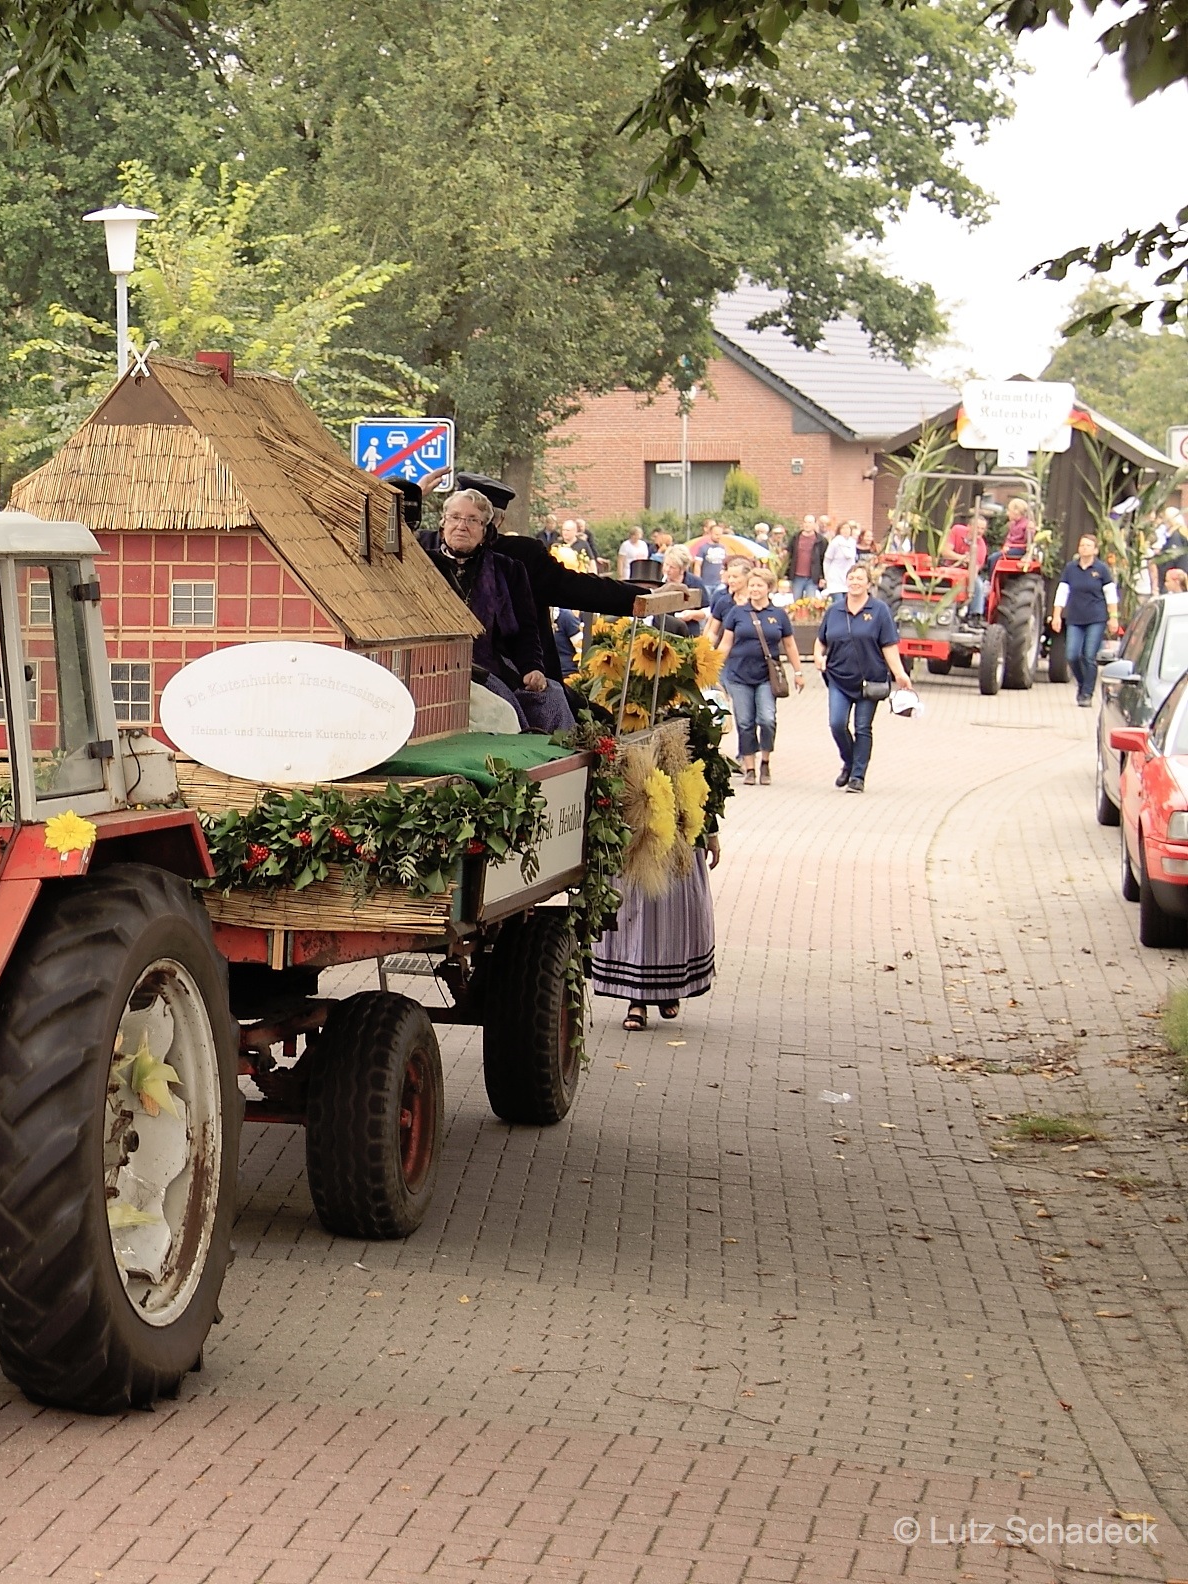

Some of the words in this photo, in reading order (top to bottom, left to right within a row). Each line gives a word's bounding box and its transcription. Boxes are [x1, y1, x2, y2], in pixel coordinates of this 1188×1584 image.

[1007, 451, 1016, 464] 5
[183, 691, 206, 708] De
[297, 672, 396, 713] Trachtensinger
[190, 725, 232, 736] Heimat-
[234, 727, 253, 737] und
[256, 727, 312, 738] Kulturkreis
[315, 728, 367, 740] Kutenholz
